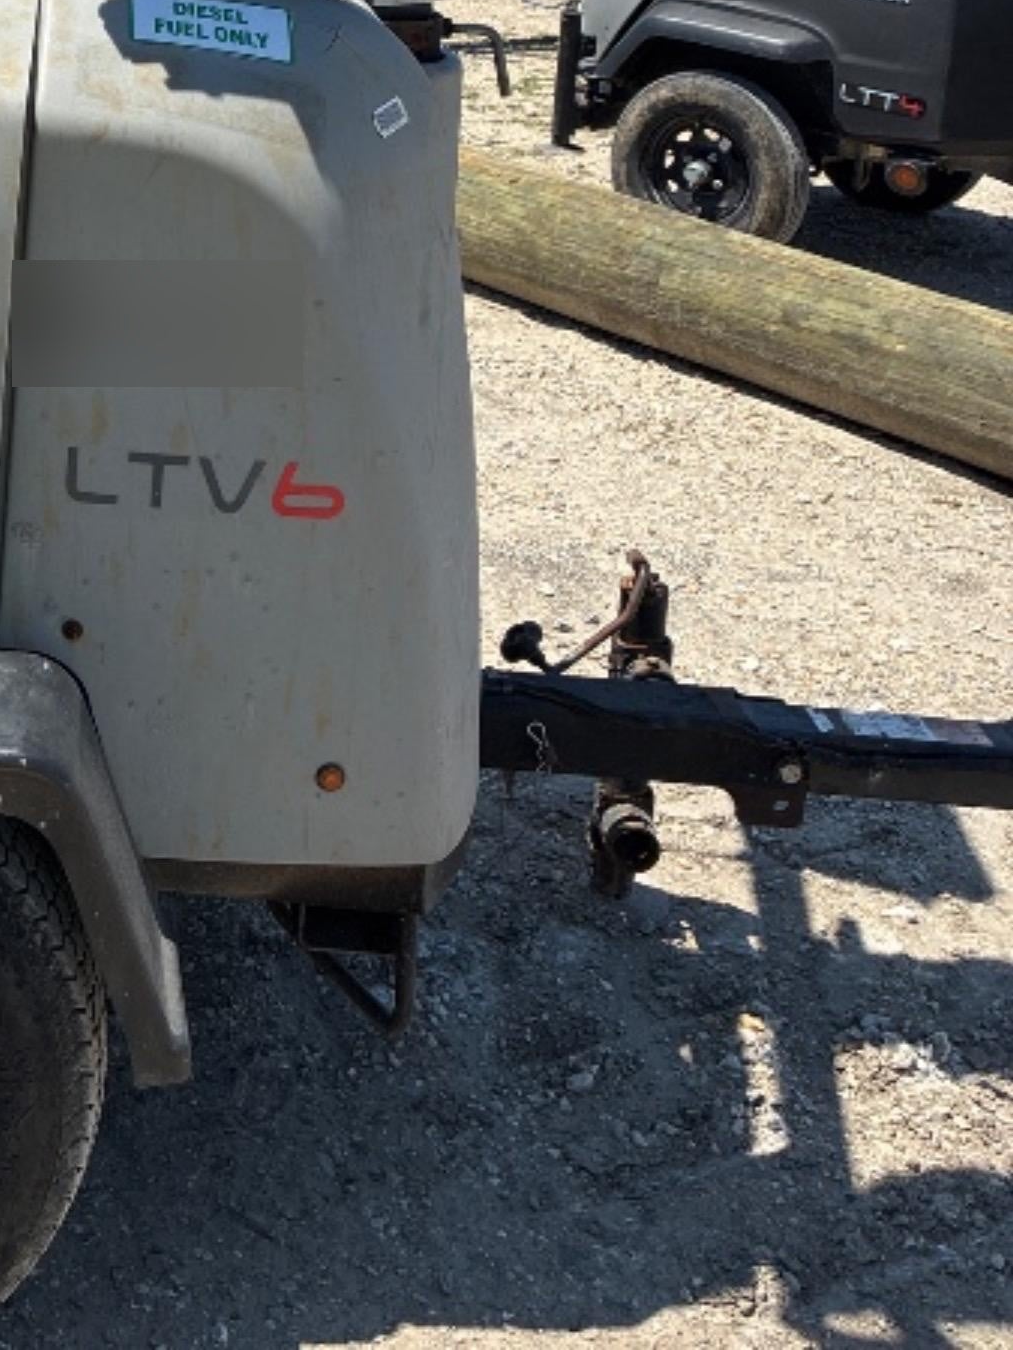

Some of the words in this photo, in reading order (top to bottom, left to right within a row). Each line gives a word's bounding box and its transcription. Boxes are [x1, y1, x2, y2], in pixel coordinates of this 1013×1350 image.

[172, 2, 249, 25] DIESEL
[154, 17, 210, 40] FUEL
[214, 25, 270, 49] ONLY
[65, 446, 345, 519] LTV6
